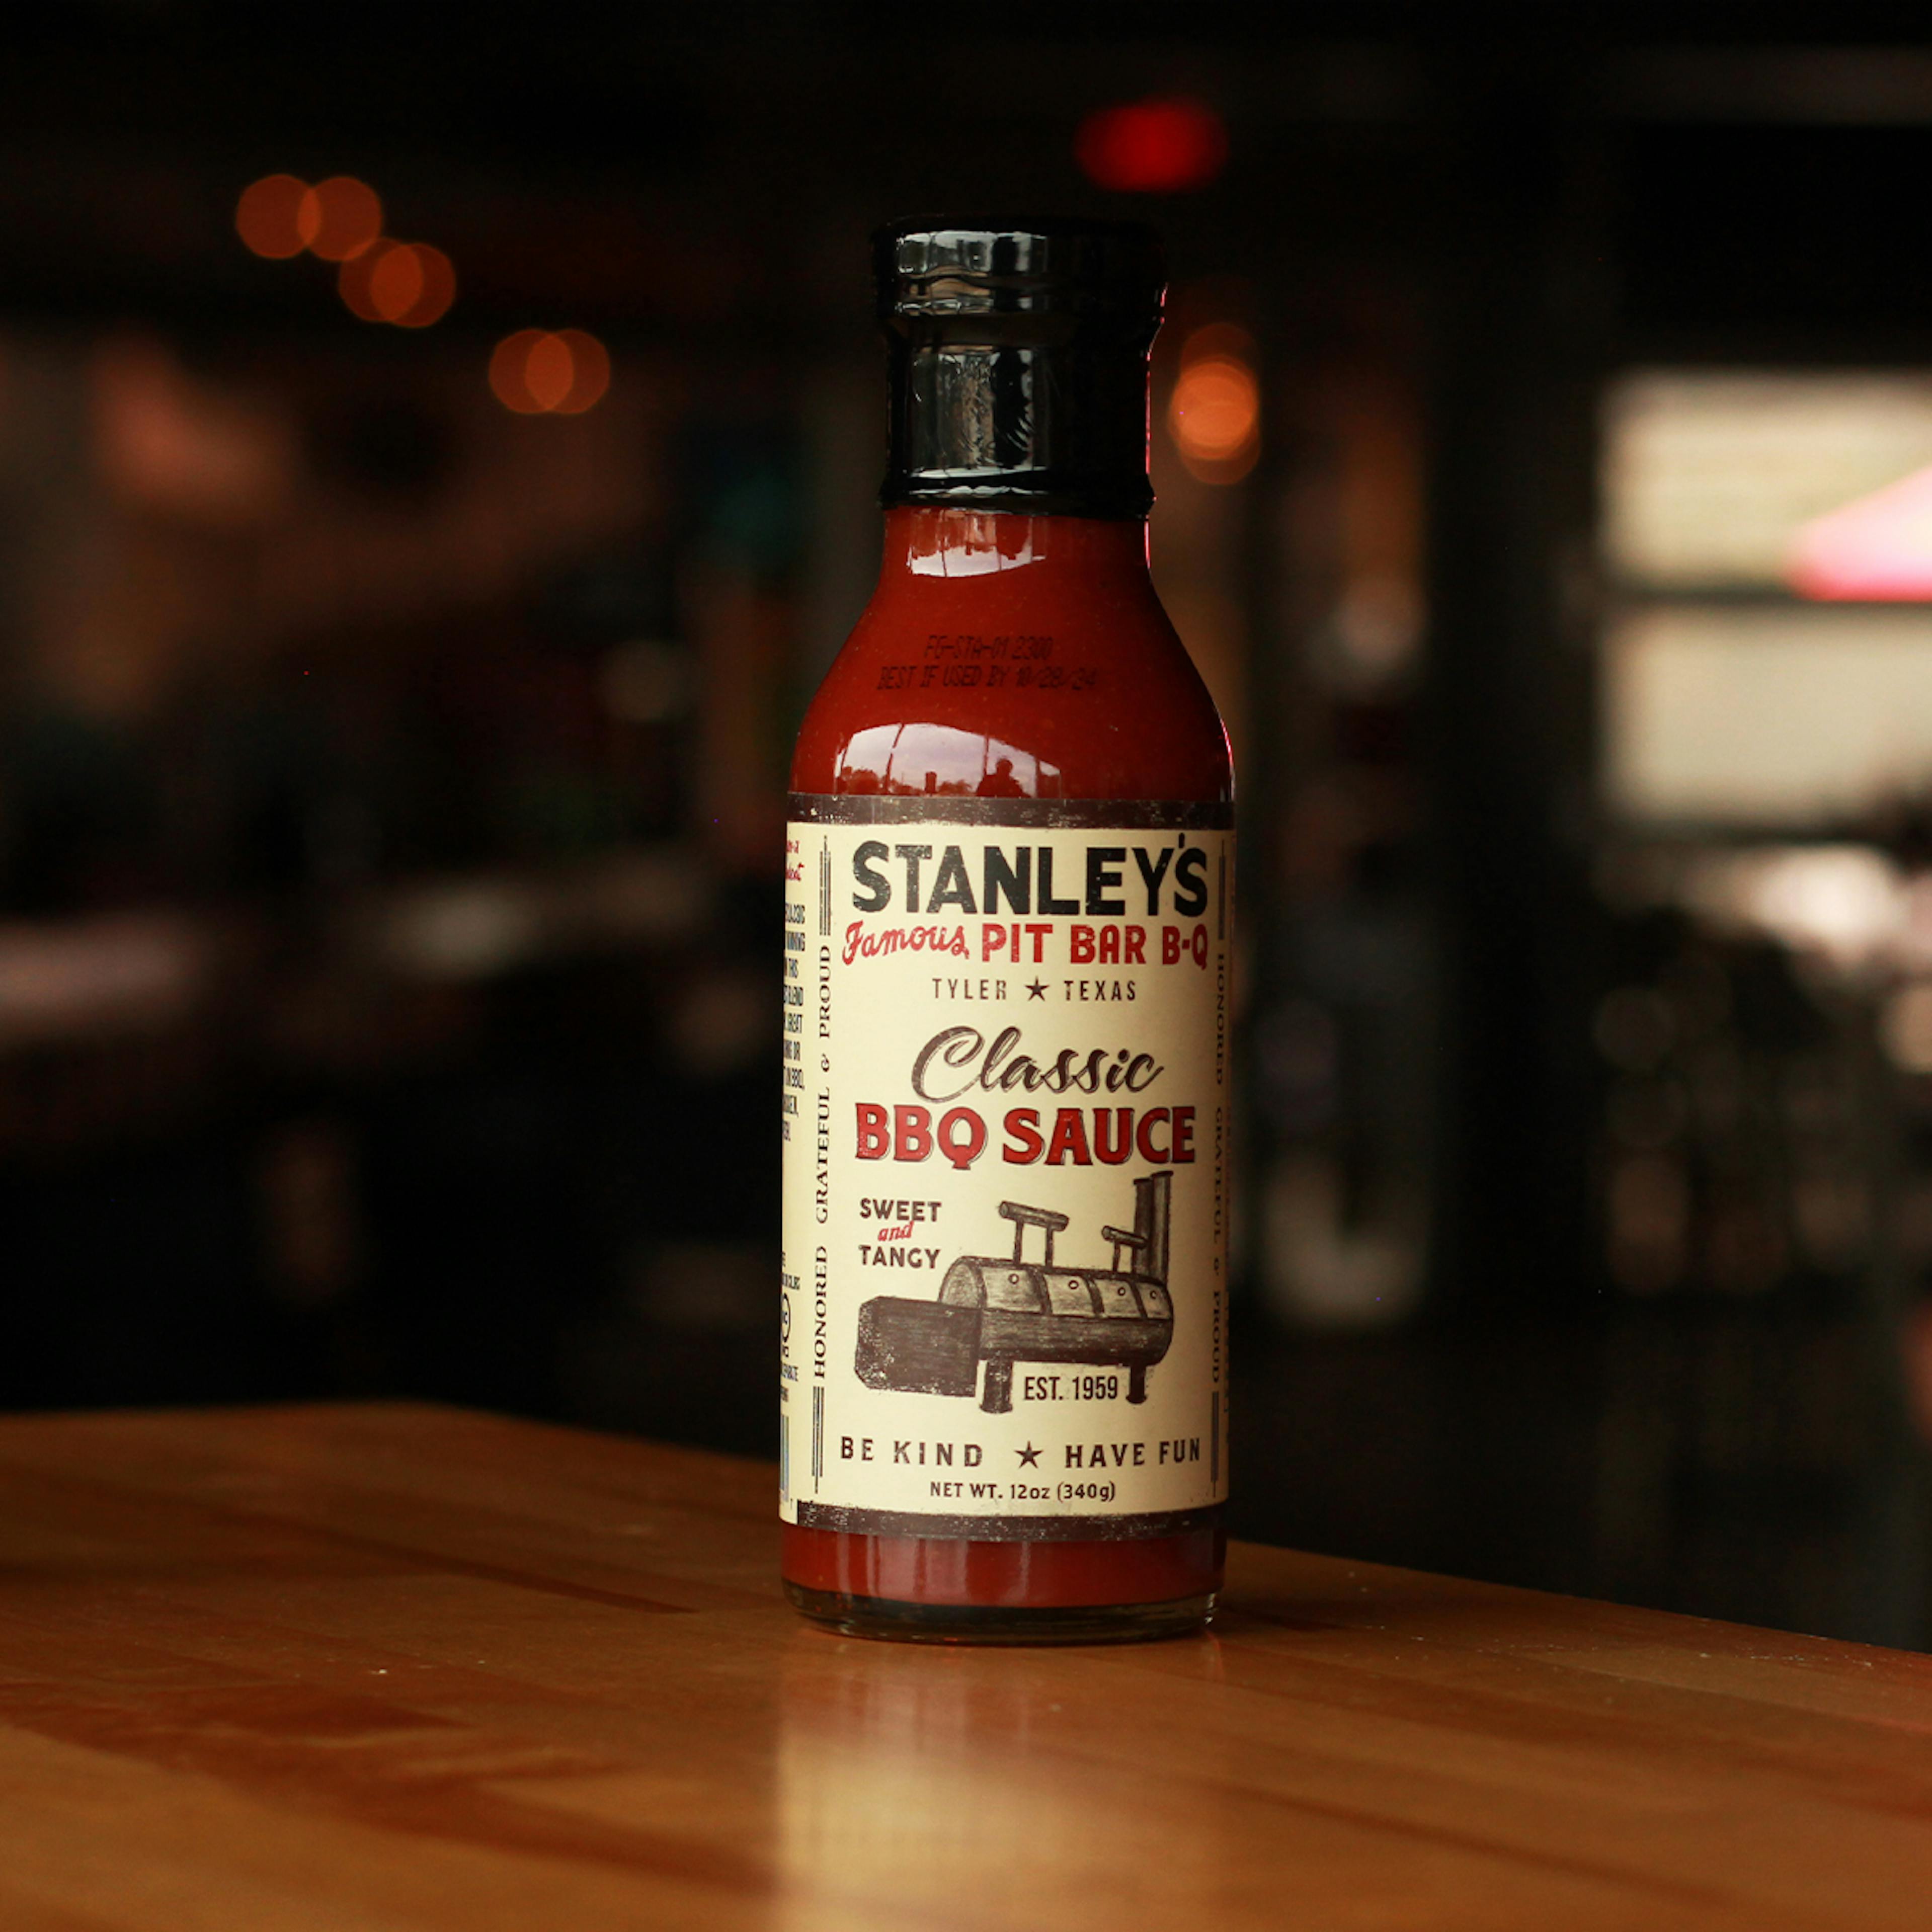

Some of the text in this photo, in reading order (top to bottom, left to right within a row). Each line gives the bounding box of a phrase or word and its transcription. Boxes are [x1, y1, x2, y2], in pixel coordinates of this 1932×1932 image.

[877, 666, 917, 690] BEST
[920, 666, 939, 688] IF
[942, 665, 983, 688] USED
[986, 665, 1010, 688] BY
[853, 833, 1208, 917] STANLEY'S
[842, 920, 970, 966] Famous
[982, 923, 1054, 963] PIT
[1070, 924, 1147, 964] BAR
[1162, 922, 1207, 970] B-Q
[819, 945, 830, 1038] PROUD
[932, 978, 1136, 1002] TYLER TEXAS
[1216, 953, 1225, 1086] HONORED
[911, 1025, 1164, 1103] Classic
[816, 1087, 830, 1224] GRATEFUL
[855, 1103, 1195, 1170] BBQ SAUCE
[1214, 1107, 1223, 1244] GRATEFUL
[859, 1197, 942, 1222] SWEET
[877, 1221, 914, 1242] and
[858, 1244, 941, 1269] TANGY
[814, 1246, 827, 1379] HONORED
[1212, 1290, 1222, 1383] PROUD
[1024, 1375, 1118, 1401] EST. 1959
[841, 1436, 1200, 1468] BE KIND HAVE FUN
[930, 1481, 1116, 1503] NET WT. 12oz (340g)
